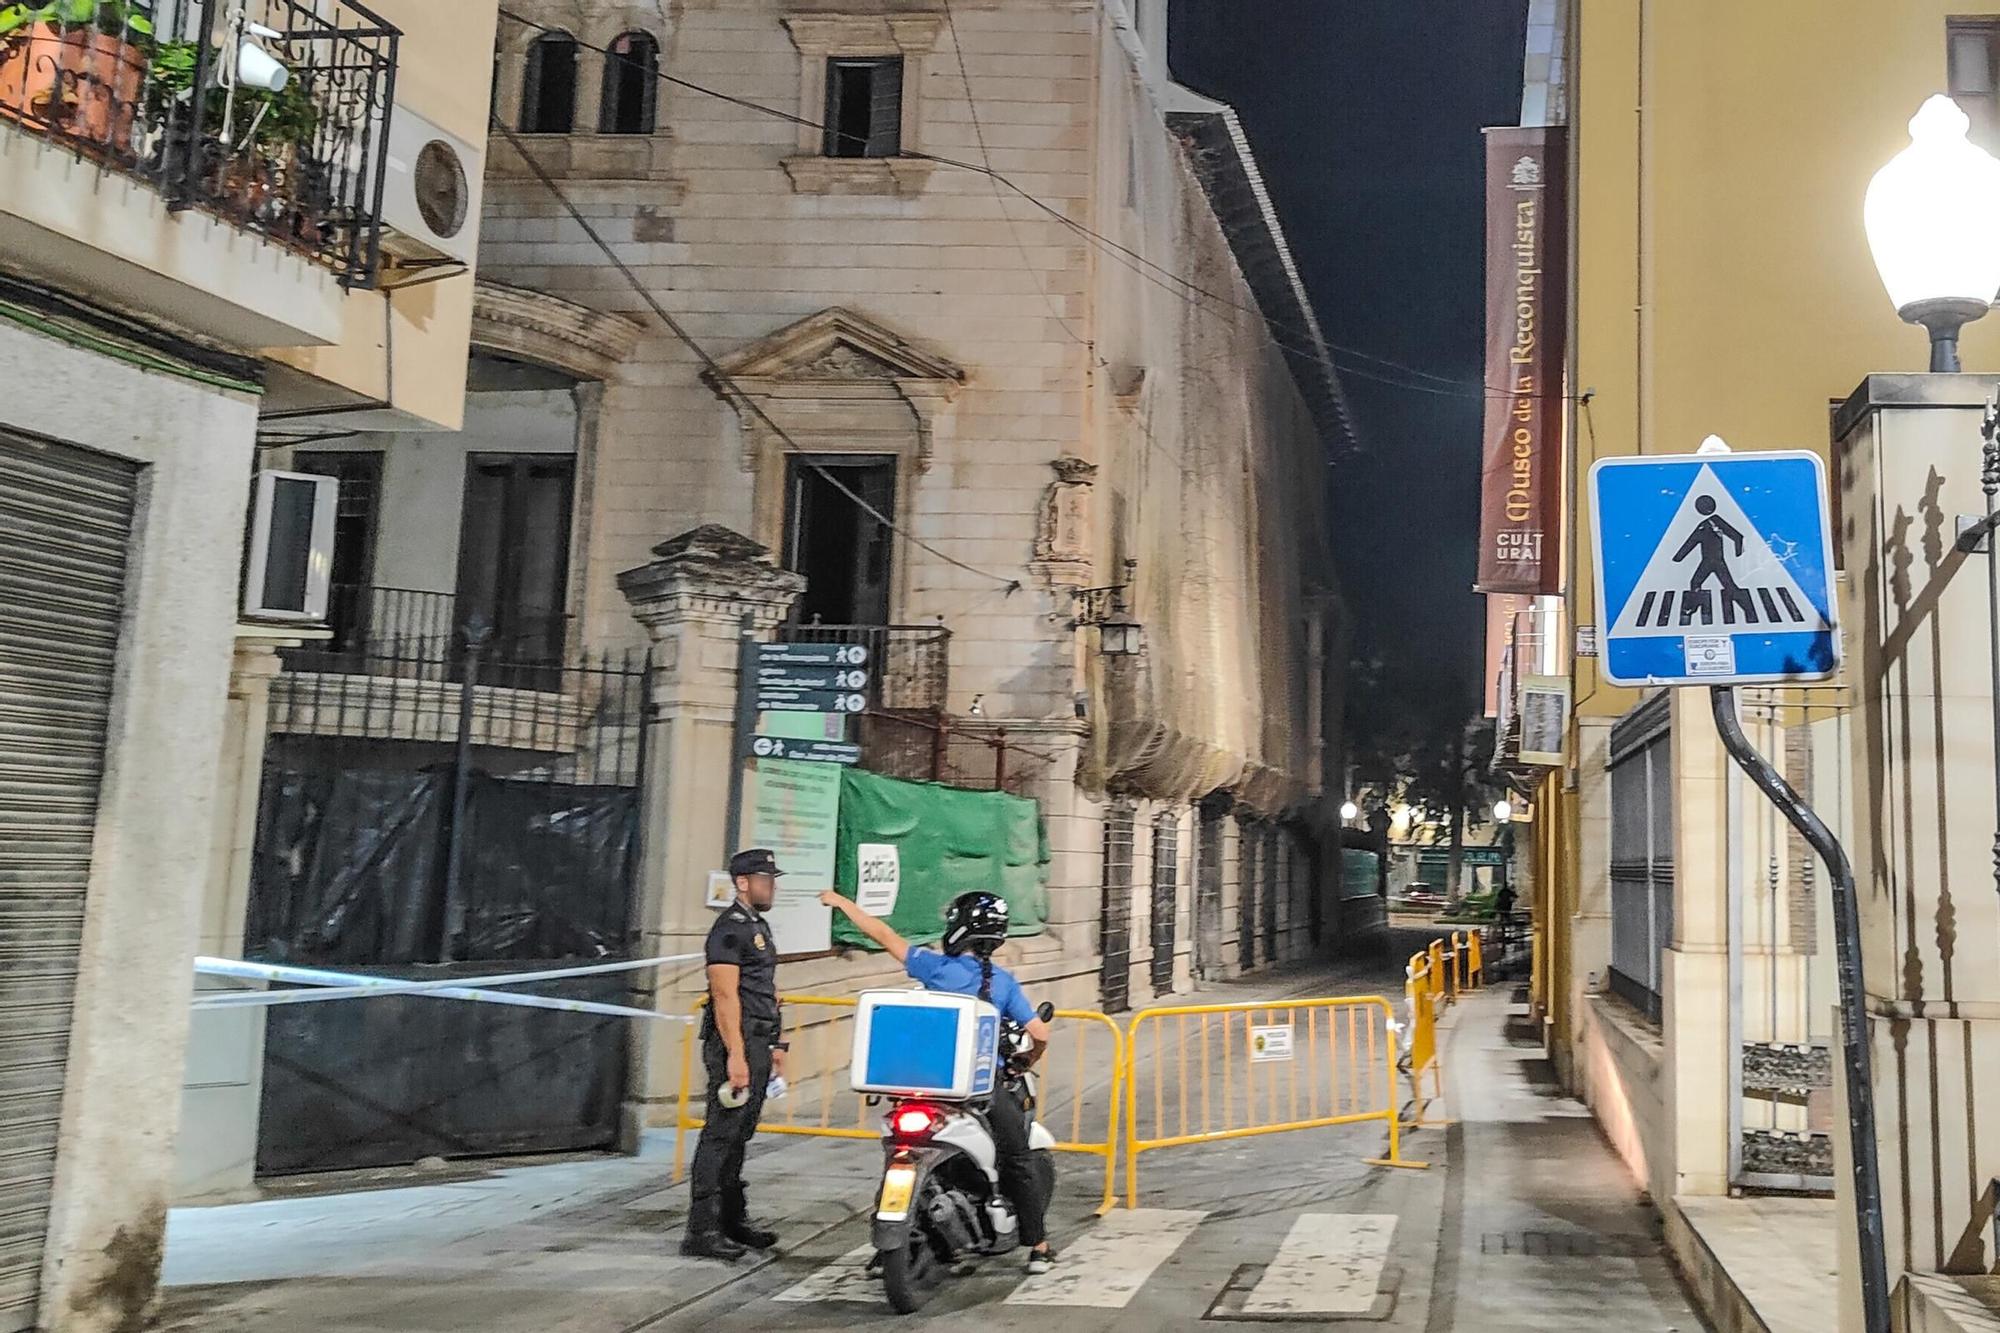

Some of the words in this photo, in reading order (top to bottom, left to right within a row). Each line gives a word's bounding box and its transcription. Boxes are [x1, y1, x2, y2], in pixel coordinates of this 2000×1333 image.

[1509, 200, 1542, 365] Reconquista
[1513, 375, 1532, 394] la
[1513, 398, 1531, 422] de
[1506, 427, 1531, 522] Museo
